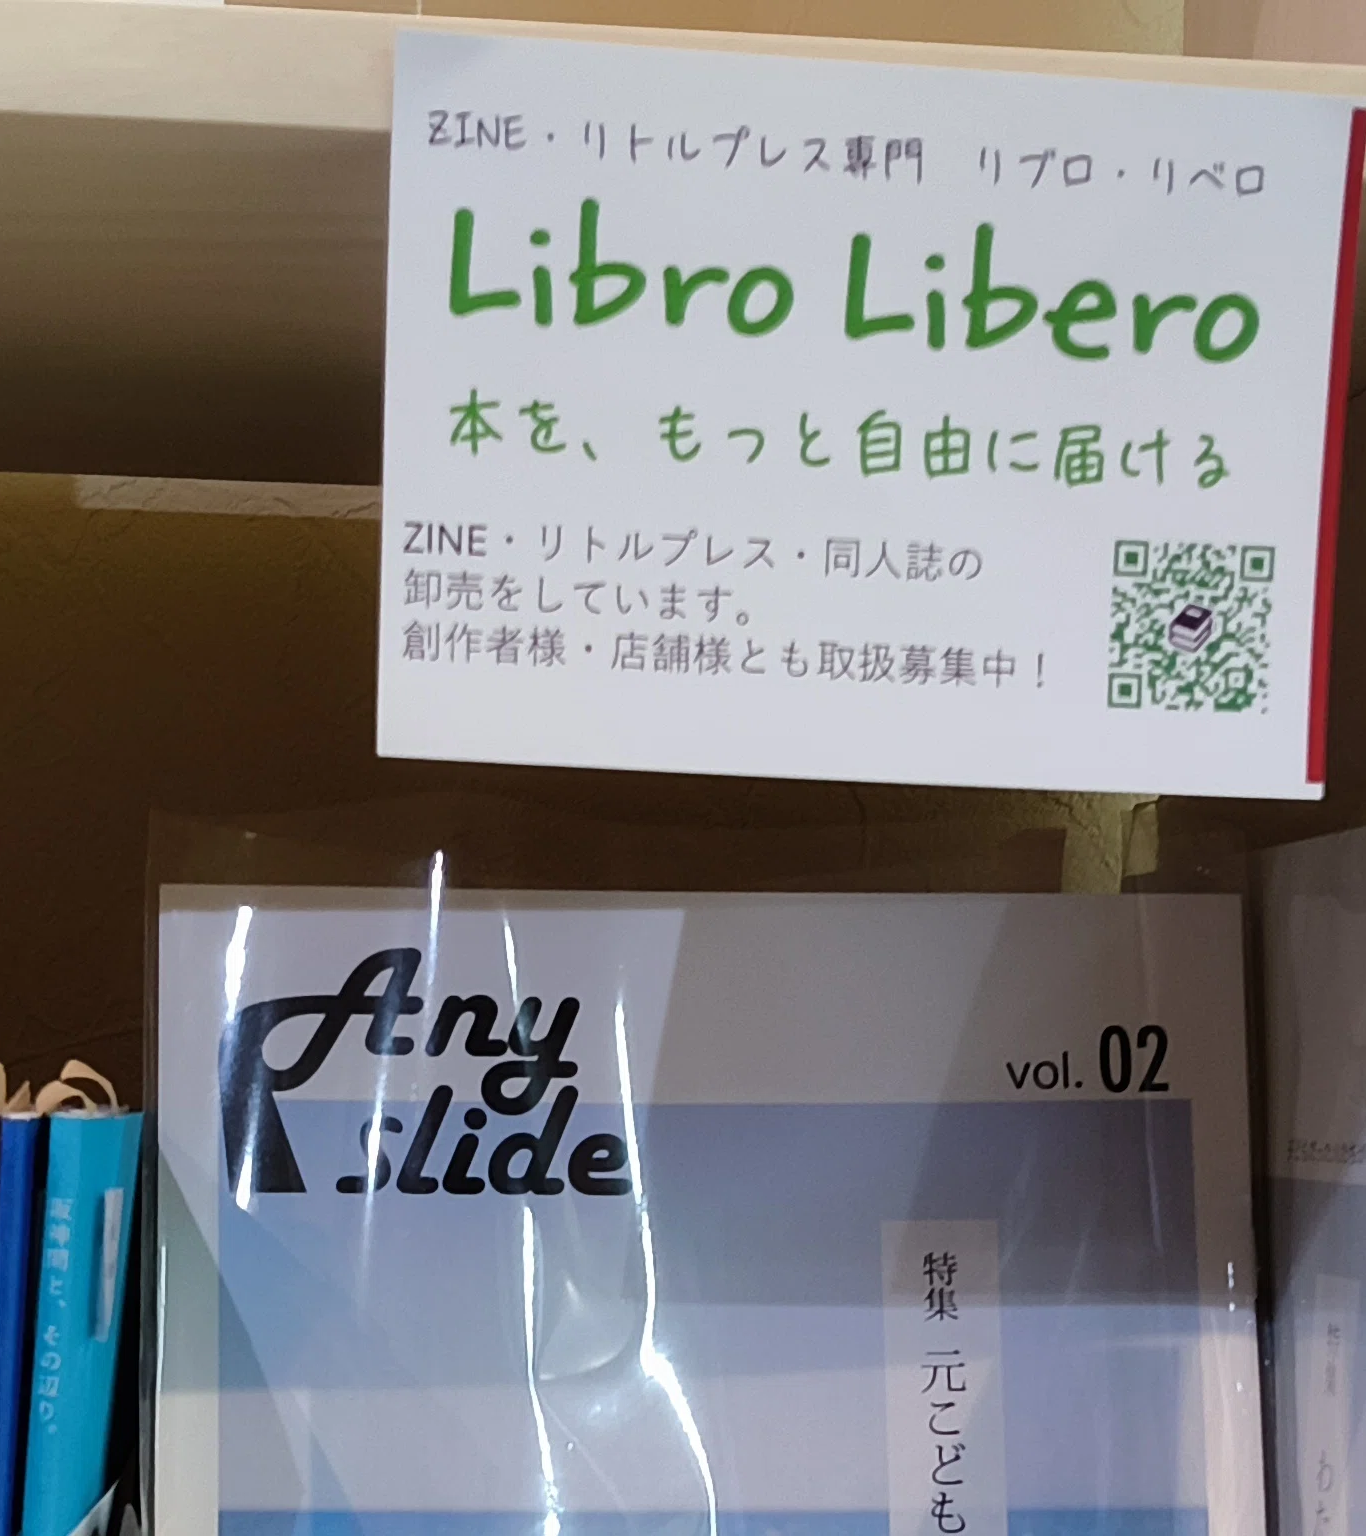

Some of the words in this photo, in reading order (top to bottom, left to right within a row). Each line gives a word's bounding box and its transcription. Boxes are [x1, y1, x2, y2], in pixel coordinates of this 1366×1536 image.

[428, 110, 922, 184] ZINE・リトルプレス専門
[980, 147, 1264, 197] リブロ・リベロ
[449, 197, 794, 337] Libro
[844, 223, 1259, 363] Libero
[450, 388, 1229, 489] 本を、もっと自由に届ける
[403, 521, 982, 582] ZINE・リトルプレス・同人誌の
[404, 568, 750, 627] 卸売をしています。
[403, 620, 1046, 689] 創作者様・店舗様とも取扱募集中！
[220, 947, 580, 1117] Any
[1006, 1051, 1083, 1089] vol.
[1099, 1024, 1170, 1094] 02
[335, 1086, 632, 1197] slide
[922, 1252, 958, 1322] 特集
